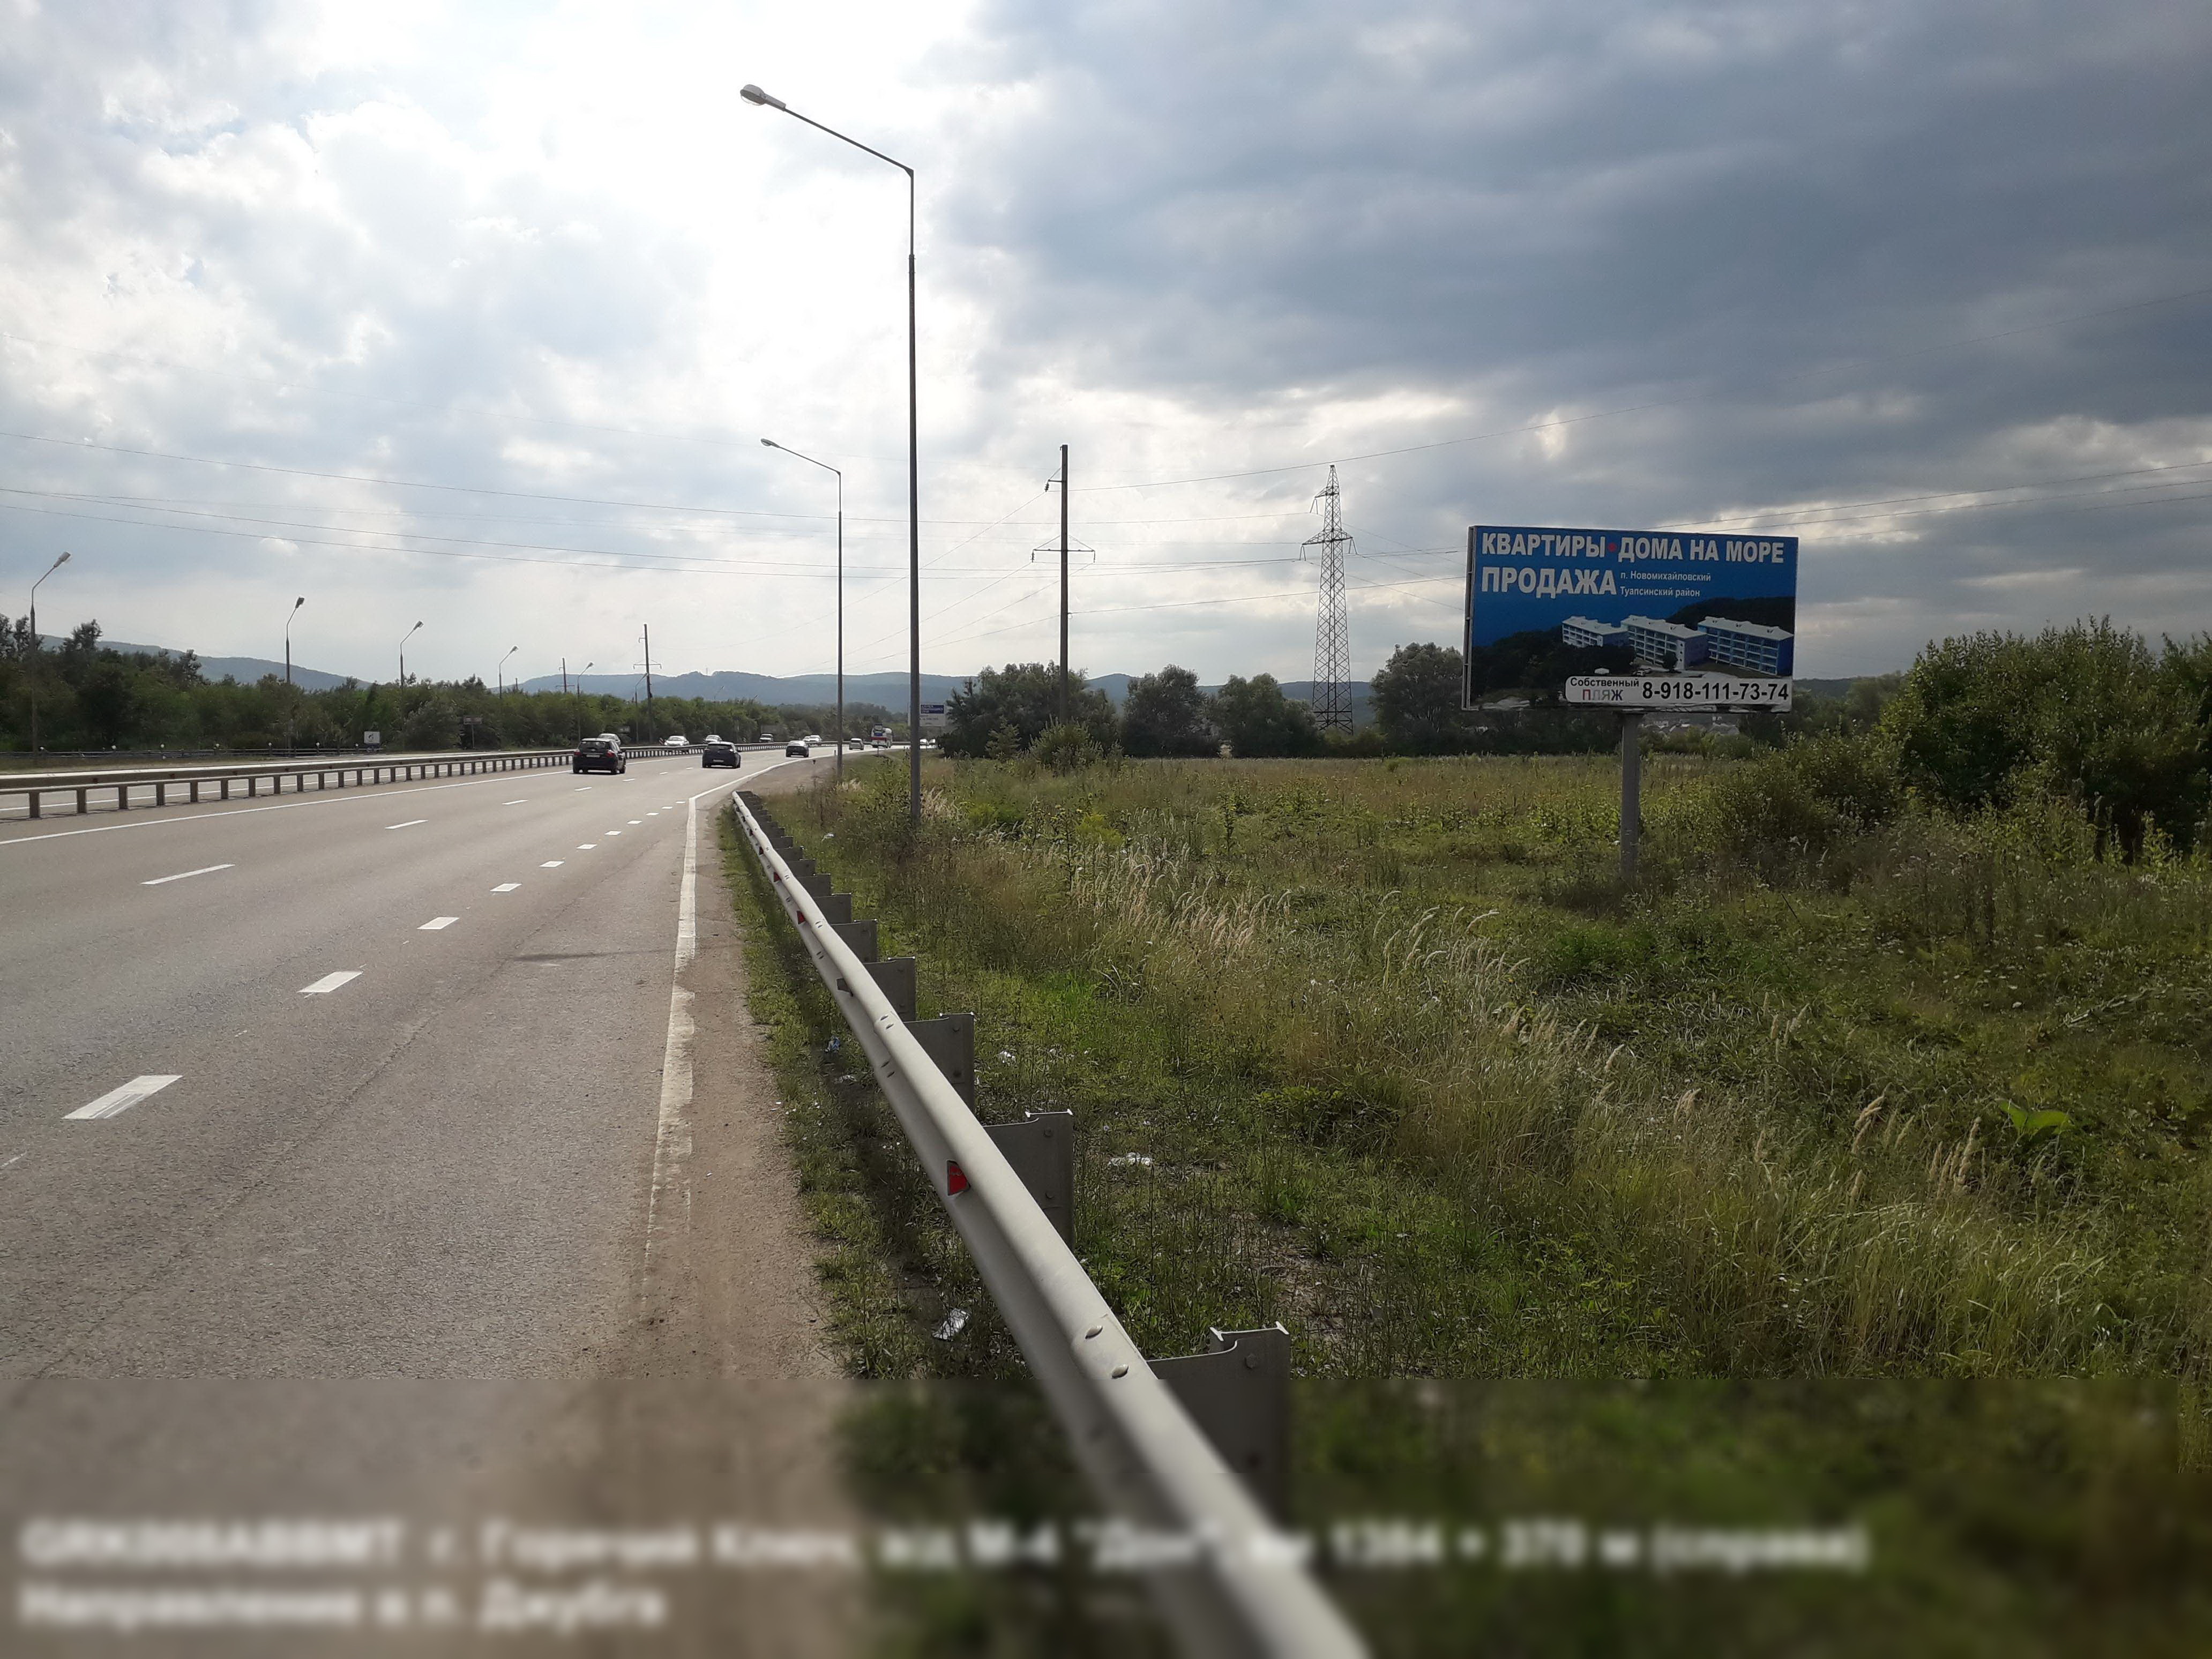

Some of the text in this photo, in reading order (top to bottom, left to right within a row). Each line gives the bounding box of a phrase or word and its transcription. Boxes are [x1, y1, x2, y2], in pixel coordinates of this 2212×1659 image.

[1482, 532, 1784, 563] КВАРТИРЫ ДОМА НА МОРЕ
[1481, 566, 1617, 599] ПРОДАЖА
[1631, 571, 1712, 582] Новомихайловский
[1620, 586, 1700, 598] Туапсинский район
[1570, 677, 1639, 687] Собственный
[1582, 687, 1623, 701] ПЛЯЖ
[1642, 681, 1789, 701] 8-918-111-73-74
